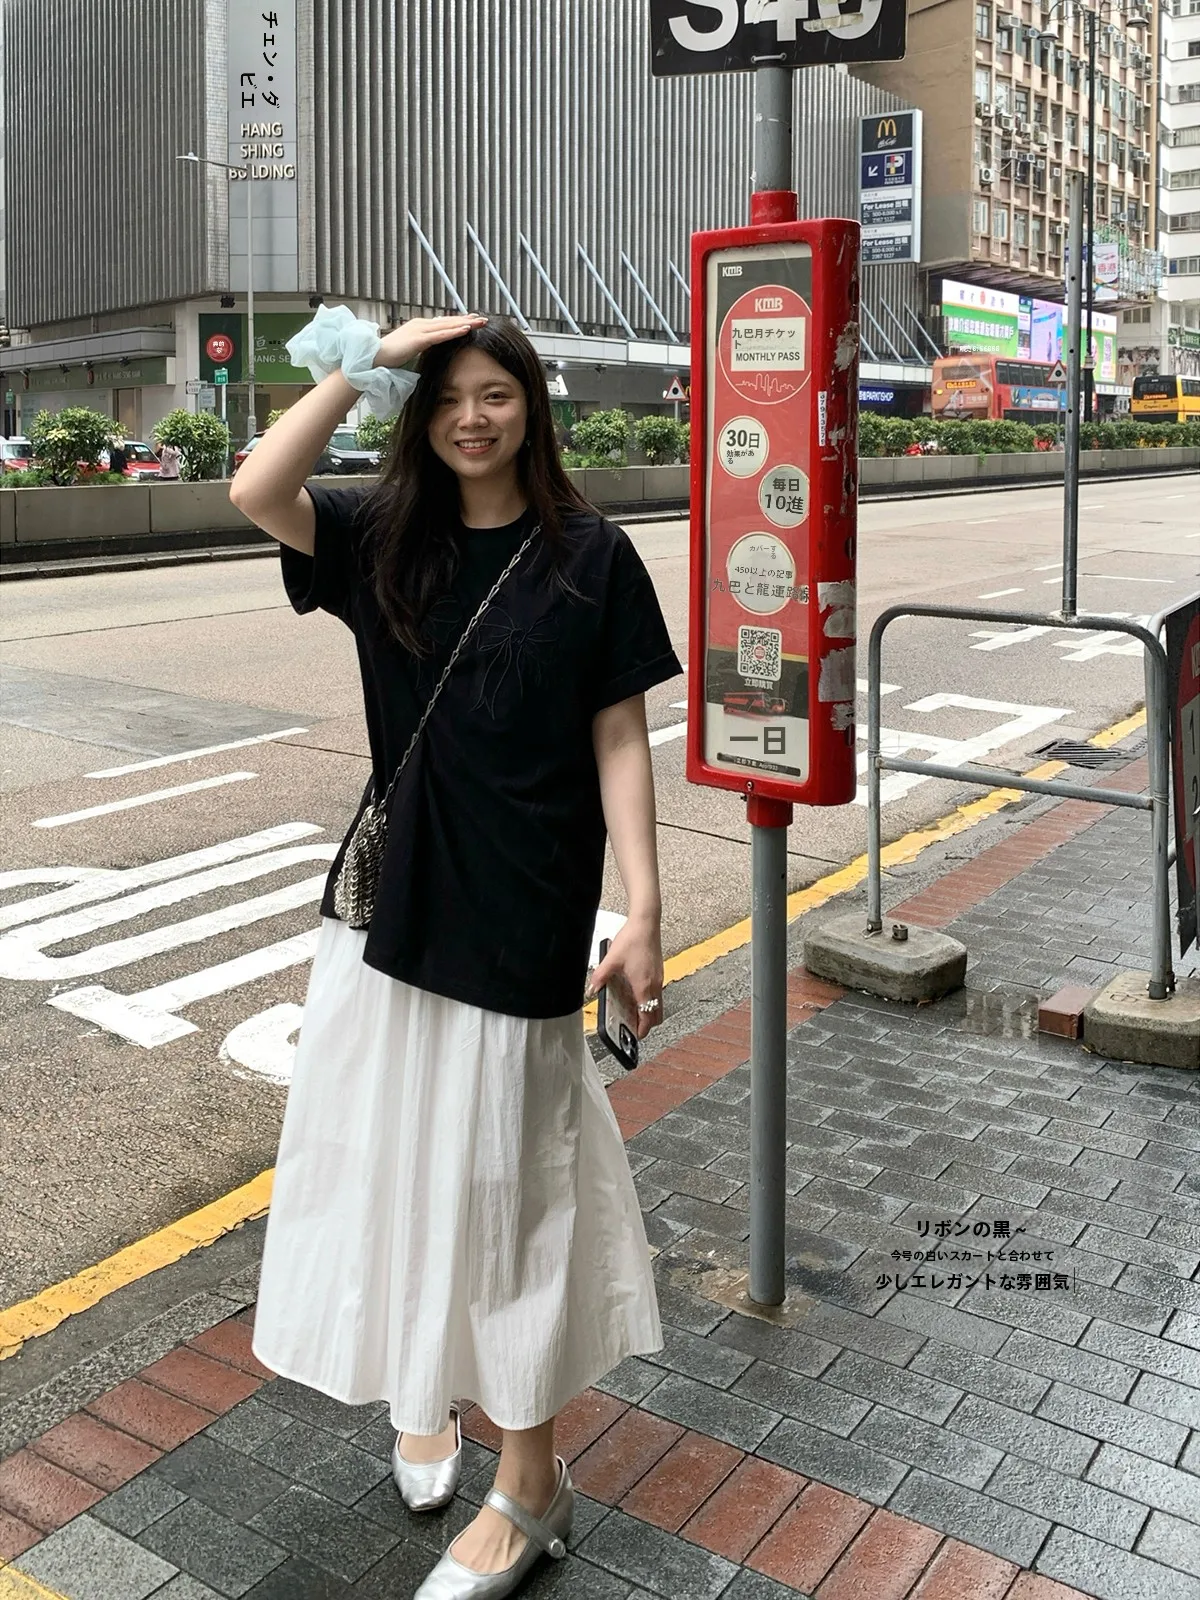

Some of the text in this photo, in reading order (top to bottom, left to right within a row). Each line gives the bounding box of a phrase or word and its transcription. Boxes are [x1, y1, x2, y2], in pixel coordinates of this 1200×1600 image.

[240, 122, 283, 138] HANG
[240, 143, 284, 158] SHING
[229, 163, 295, 179] BULDING
[874, 202, 894, 210] Lease
[722, 266, 743, 277] KMB
[754, 297, 783, 312] KMB
[736, 351, 801, 361] MONTHLY PASS
[726, 430, 760, 449] 30日
[764, 494, 804, 514] 10進
